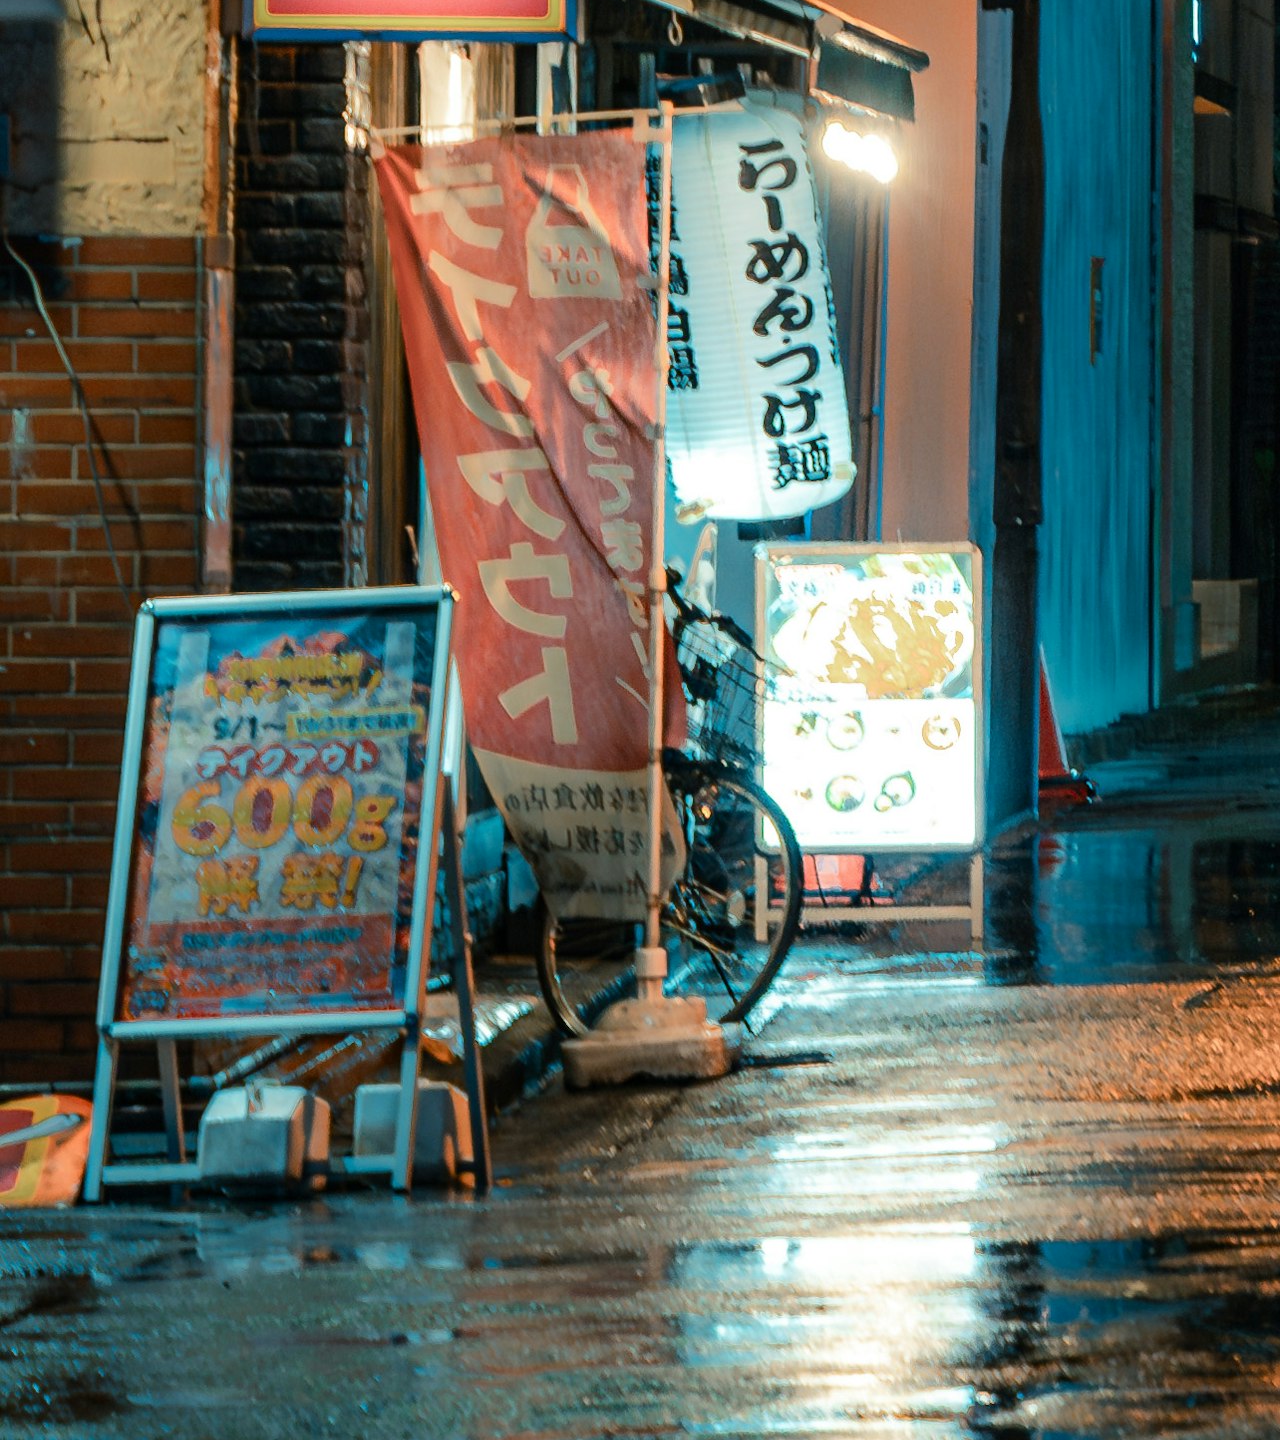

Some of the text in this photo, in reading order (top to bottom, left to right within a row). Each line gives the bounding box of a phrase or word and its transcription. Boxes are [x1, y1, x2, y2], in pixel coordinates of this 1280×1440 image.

[738, 137, 832, 491] らーめん・つけ麺
[199, 741, 377, 776] テイクアウト
[172, 773, 397, 858] 600g
